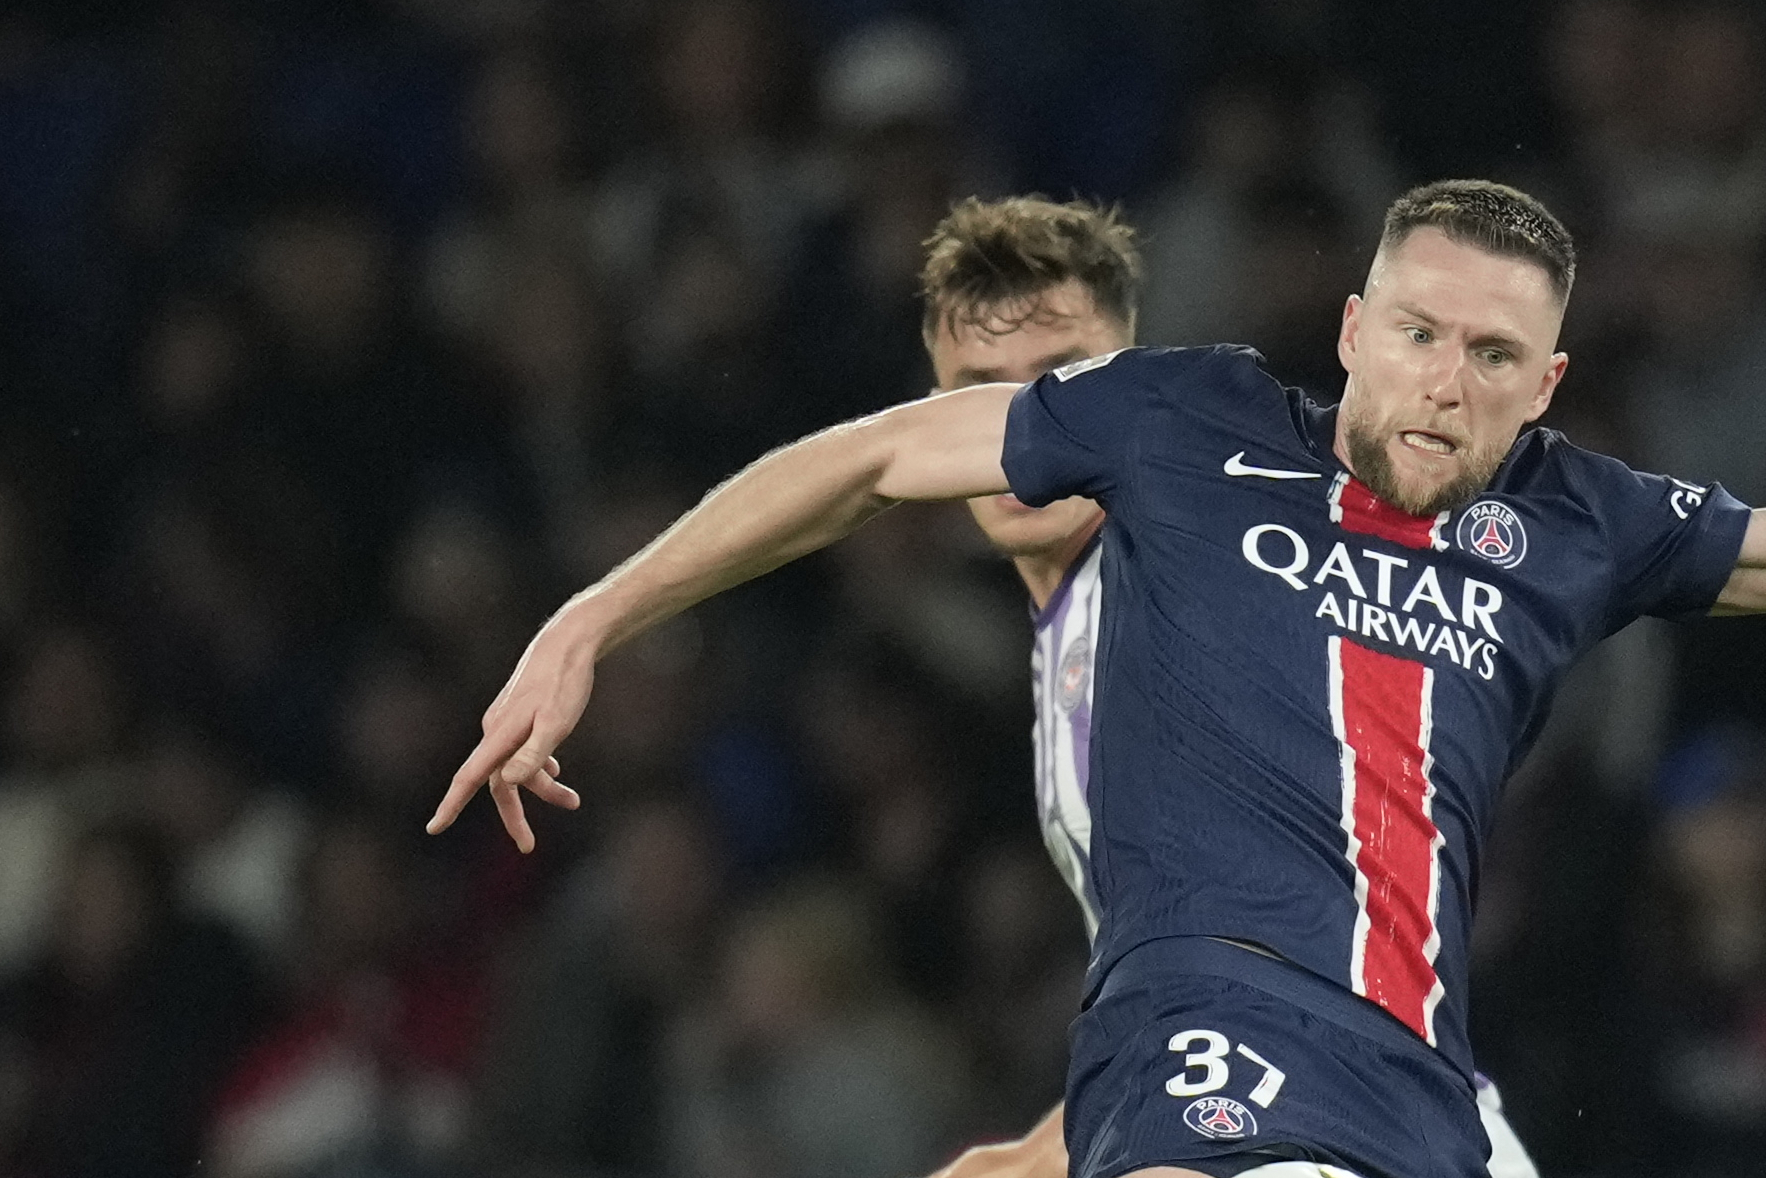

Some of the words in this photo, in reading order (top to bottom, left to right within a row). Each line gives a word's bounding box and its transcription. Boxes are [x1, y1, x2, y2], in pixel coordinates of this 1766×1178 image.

[1470, 504, 1515, 526] PARIS
[1242, 523, 1504, 644] QATAR
[1315, 591, 1499, 681] AIRWAYS
[1165, 1028, 1286, 1109] 37
[1196, 1099, 1245, 1115] PARIS
